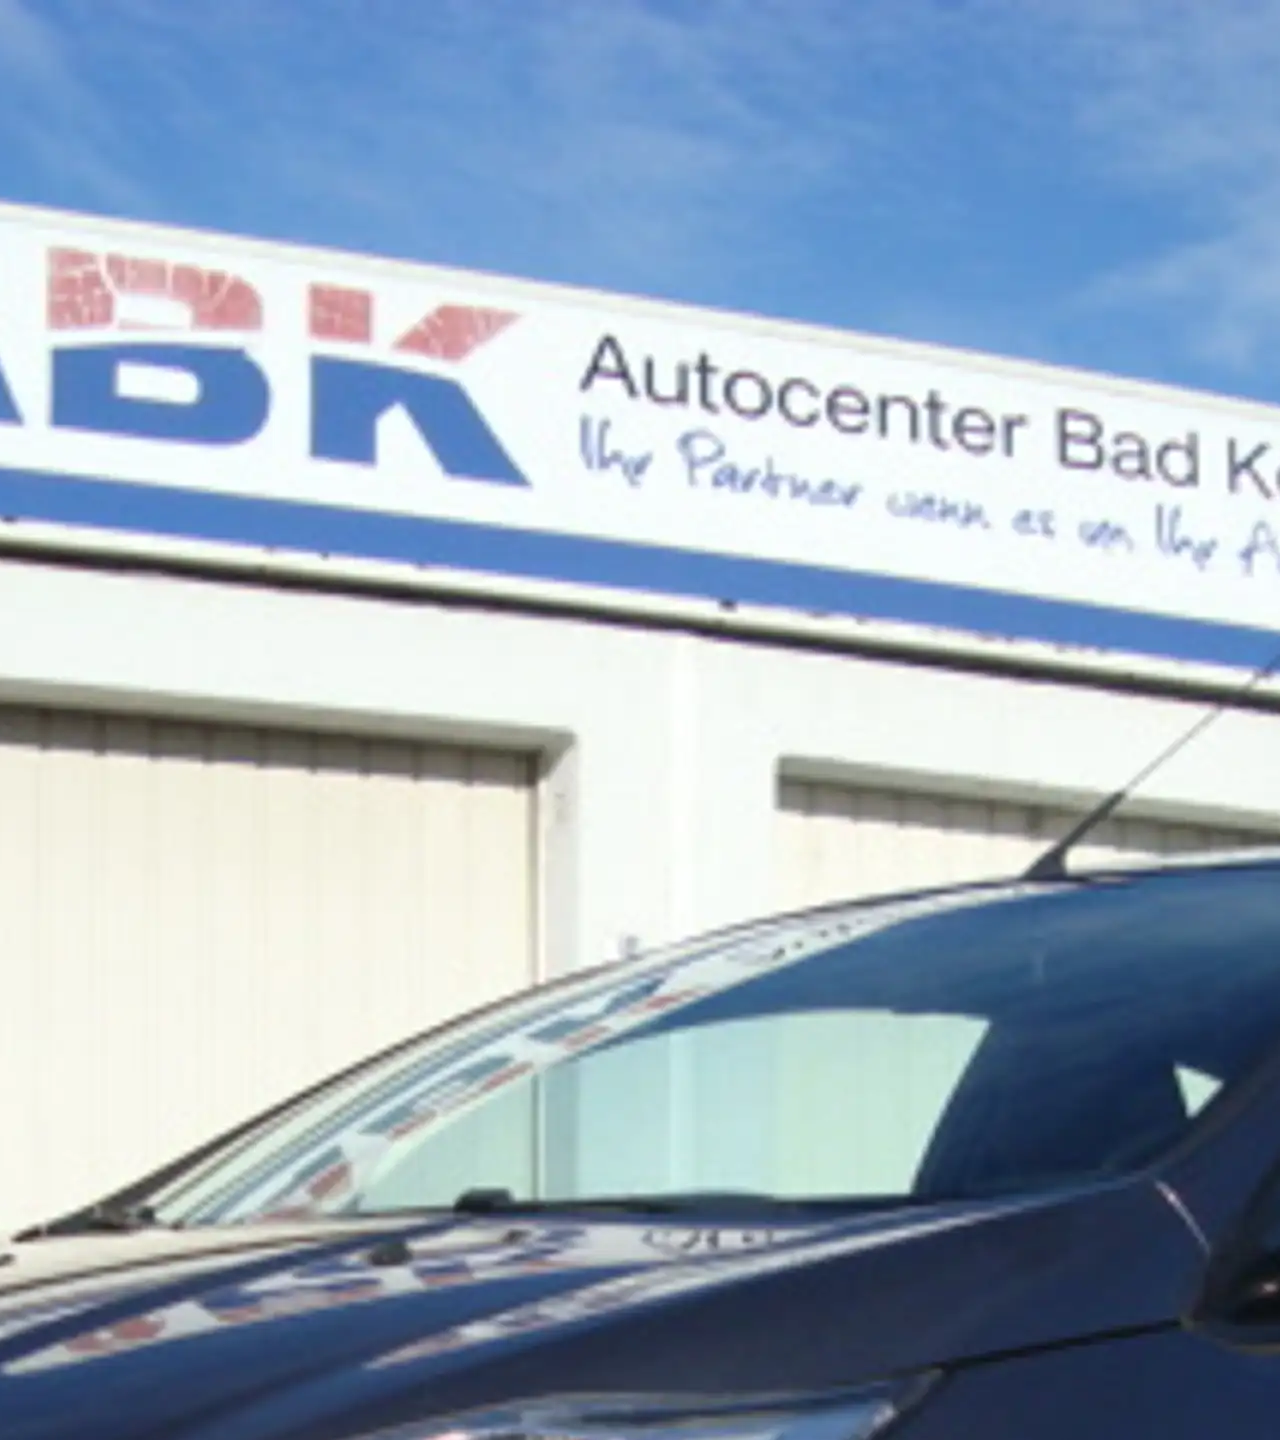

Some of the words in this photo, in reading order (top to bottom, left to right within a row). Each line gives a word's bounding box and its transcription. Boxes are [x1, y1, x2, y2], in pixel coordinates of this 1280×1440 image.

[579, 333, 1030, 457] Autocenter
[1055, 407, 1200, 488] Bad
[579, 413, 653, 487] Ihr
[676, 427, 863, 508] Partner
[1011, 508, 1057, 540] es
[1155, 503, 1218, 572] Ihr
